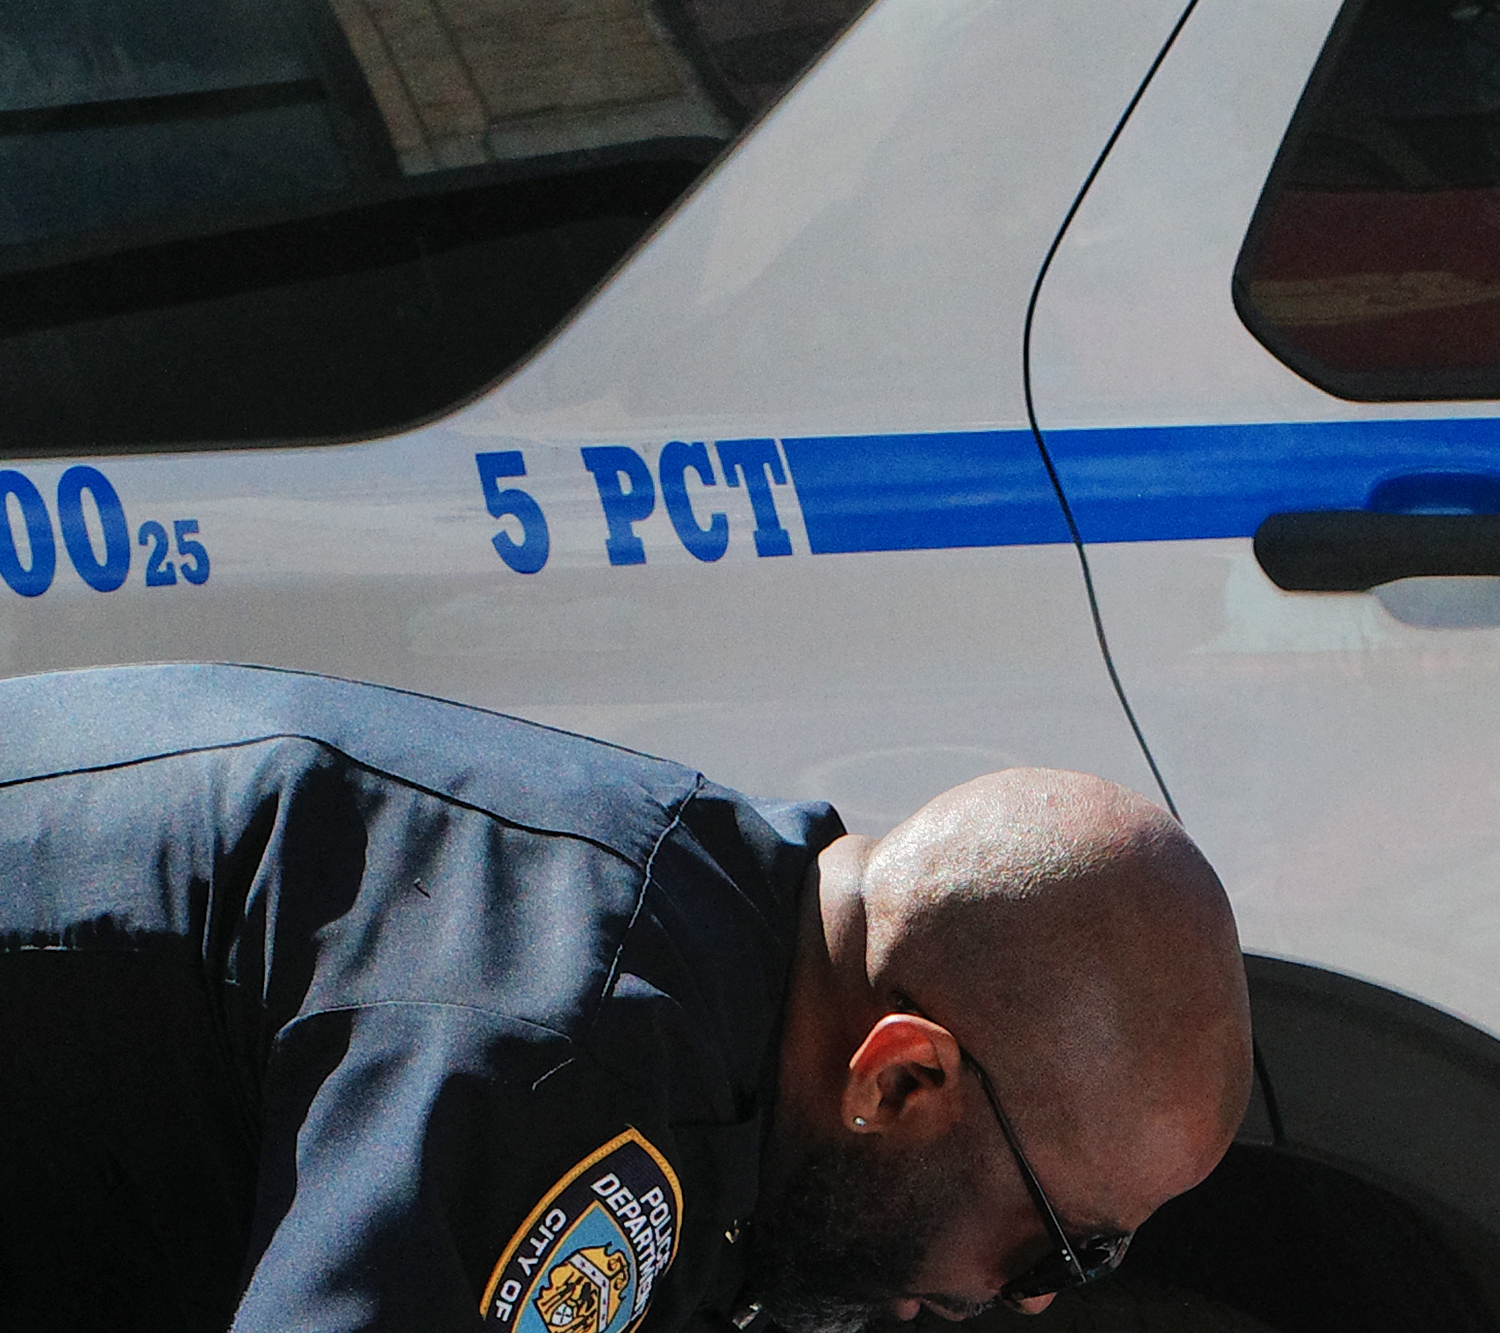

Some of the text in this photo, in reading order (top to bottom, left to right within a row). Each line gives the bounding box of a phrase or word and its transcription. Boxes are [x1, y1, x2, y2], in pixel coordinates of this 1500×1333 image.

[137, 519, 211, 588] 25
[475, 438, 793, 574] 5 PCT
[495, 1207, 567, 1323] CITY OF
[590, 1172, 661, 1322] DEPARTMENT
[641, 1186, 674, 1273] POLICE
